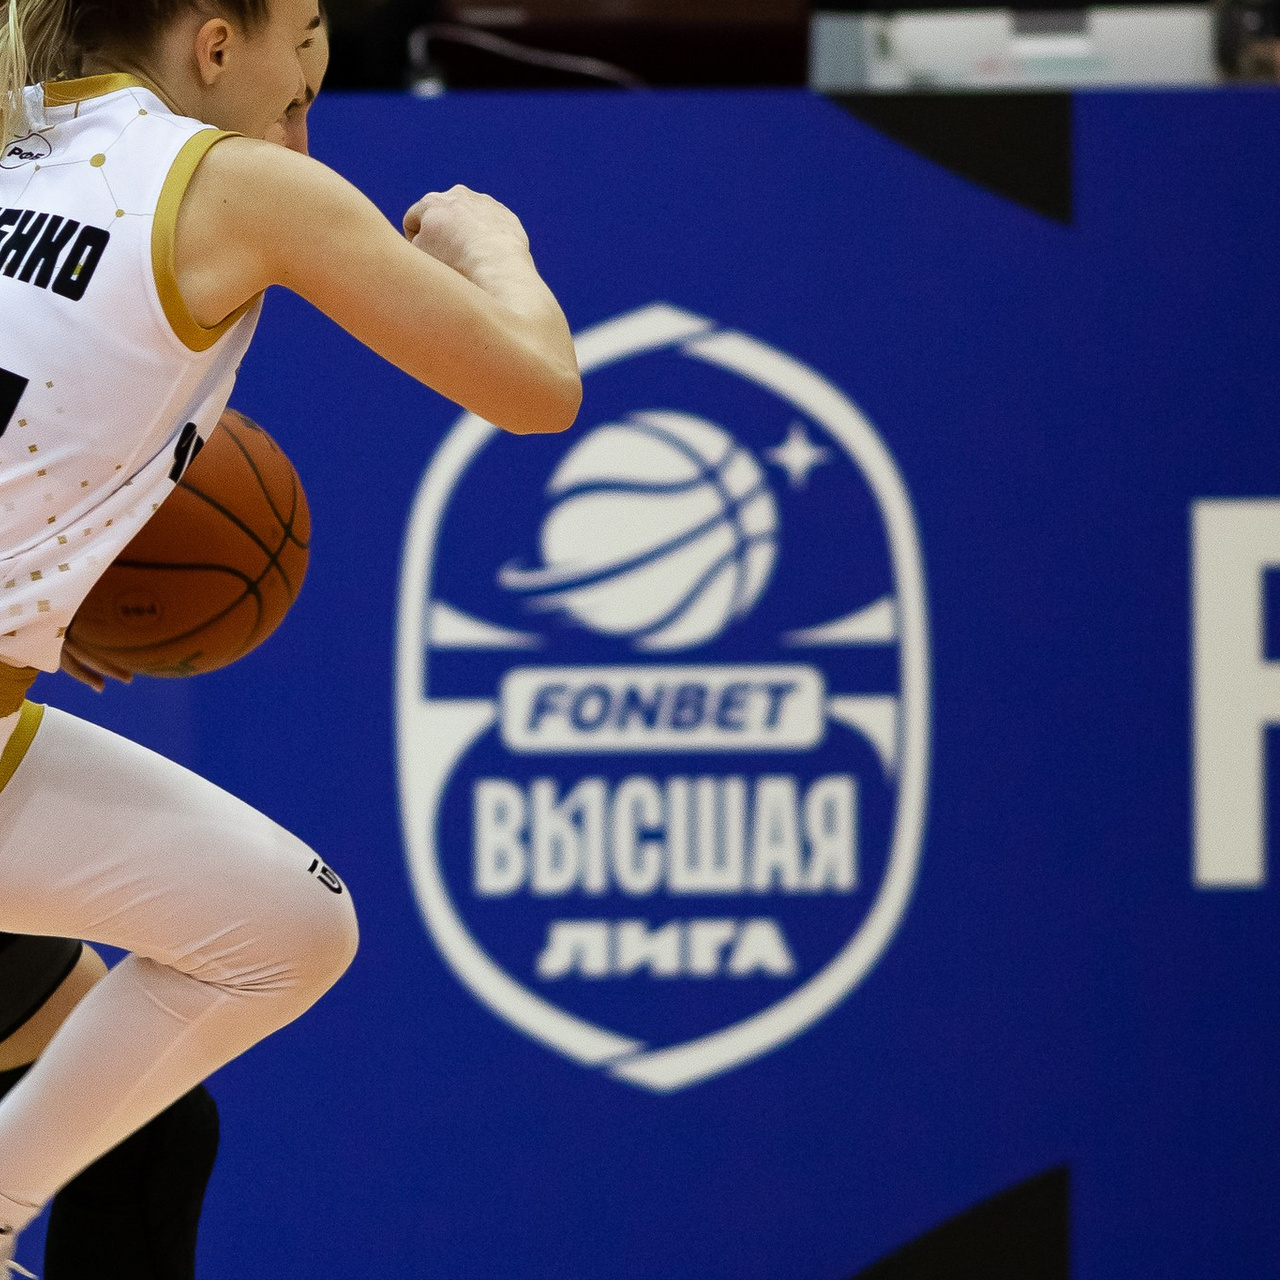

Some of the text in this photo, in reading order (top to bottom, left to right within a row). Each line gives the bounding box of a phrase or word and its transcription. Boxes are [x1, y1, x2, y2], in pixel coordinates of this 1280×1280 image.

[526, 682, 798, 733] FONBET
[474, 774, 859, 897] ВЫСШАЯ
[537, 919, 795, 979] ЛИГА
